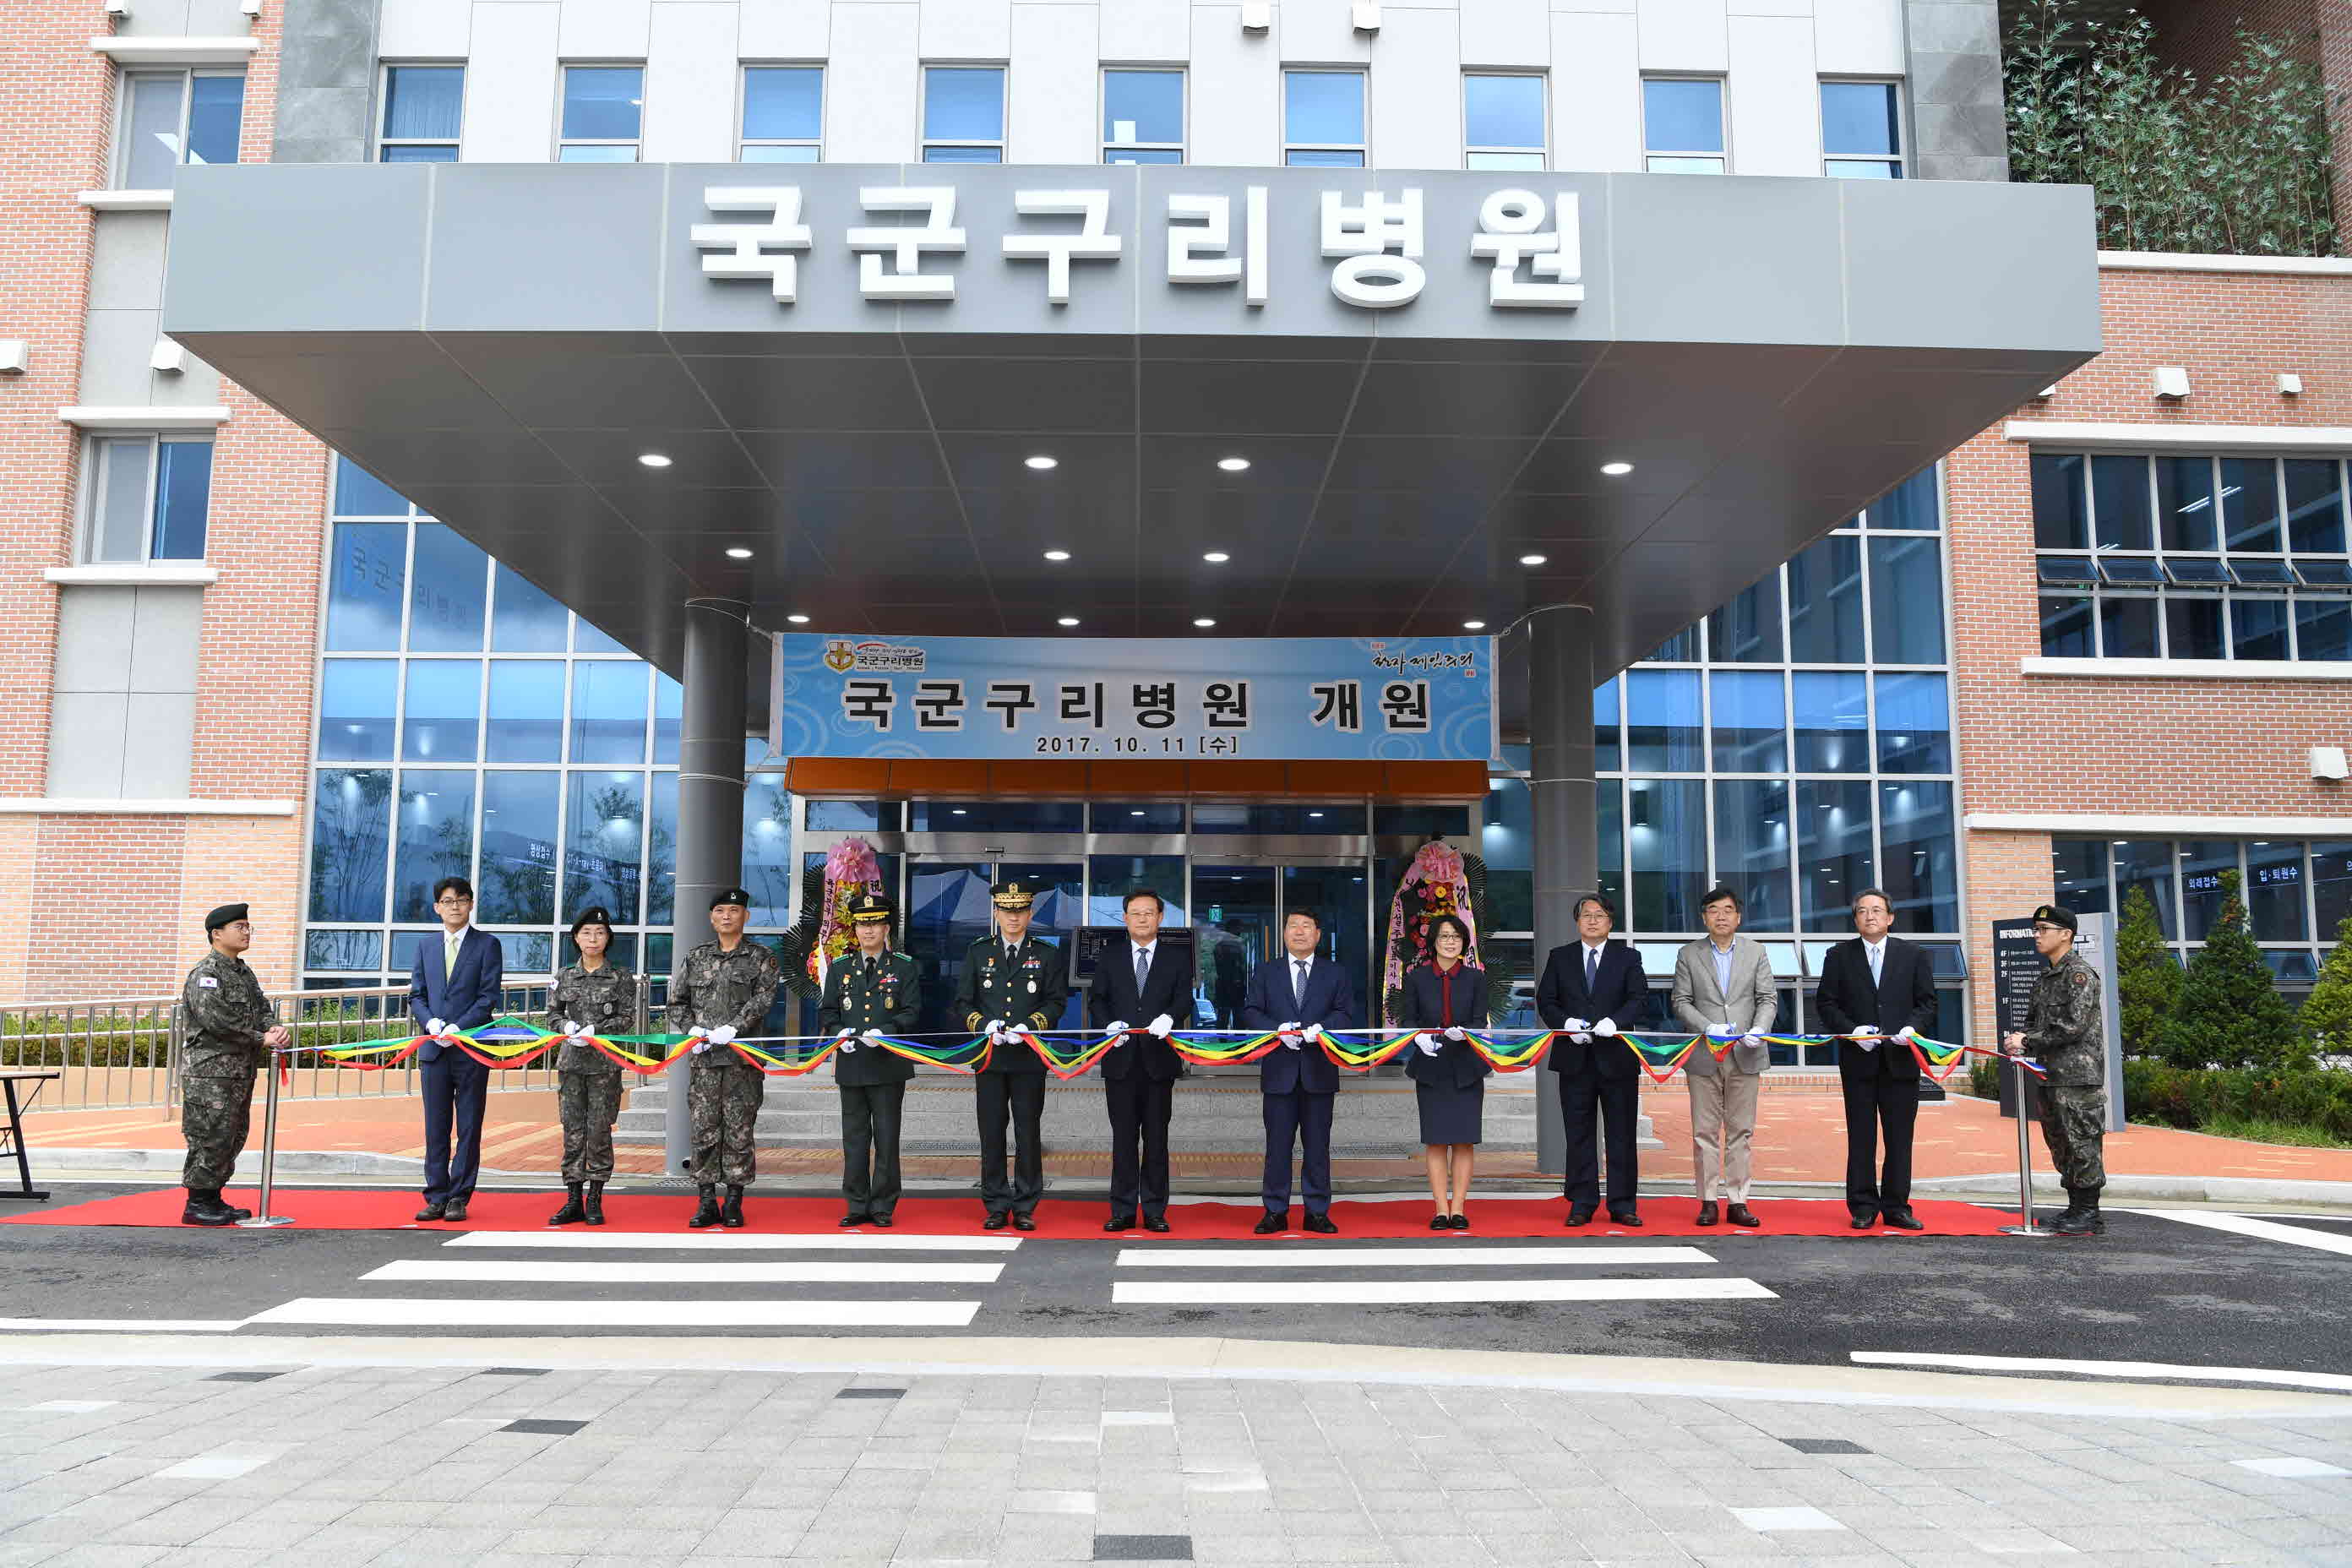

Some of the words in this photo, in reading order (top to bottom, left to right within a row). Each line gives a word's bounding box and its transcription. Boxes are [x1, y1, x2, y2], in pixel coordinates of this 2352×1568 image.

[690, 185, 1585, 310] 국군구리병원
[858, 656, 923, 667] 국군구리병원
[845, 682, 1246, 729] 국군구리병원
[1313, 682, 1427, 729] 개원
[1037, 737, 1100, 753] 2017.
[1114, 737, 1147, 753] 10.
[1162, 737, 1184, 753] 11
[1198, 735, 1239, 754] [수]
[2188, 875, 2219, 890] 외래접수
